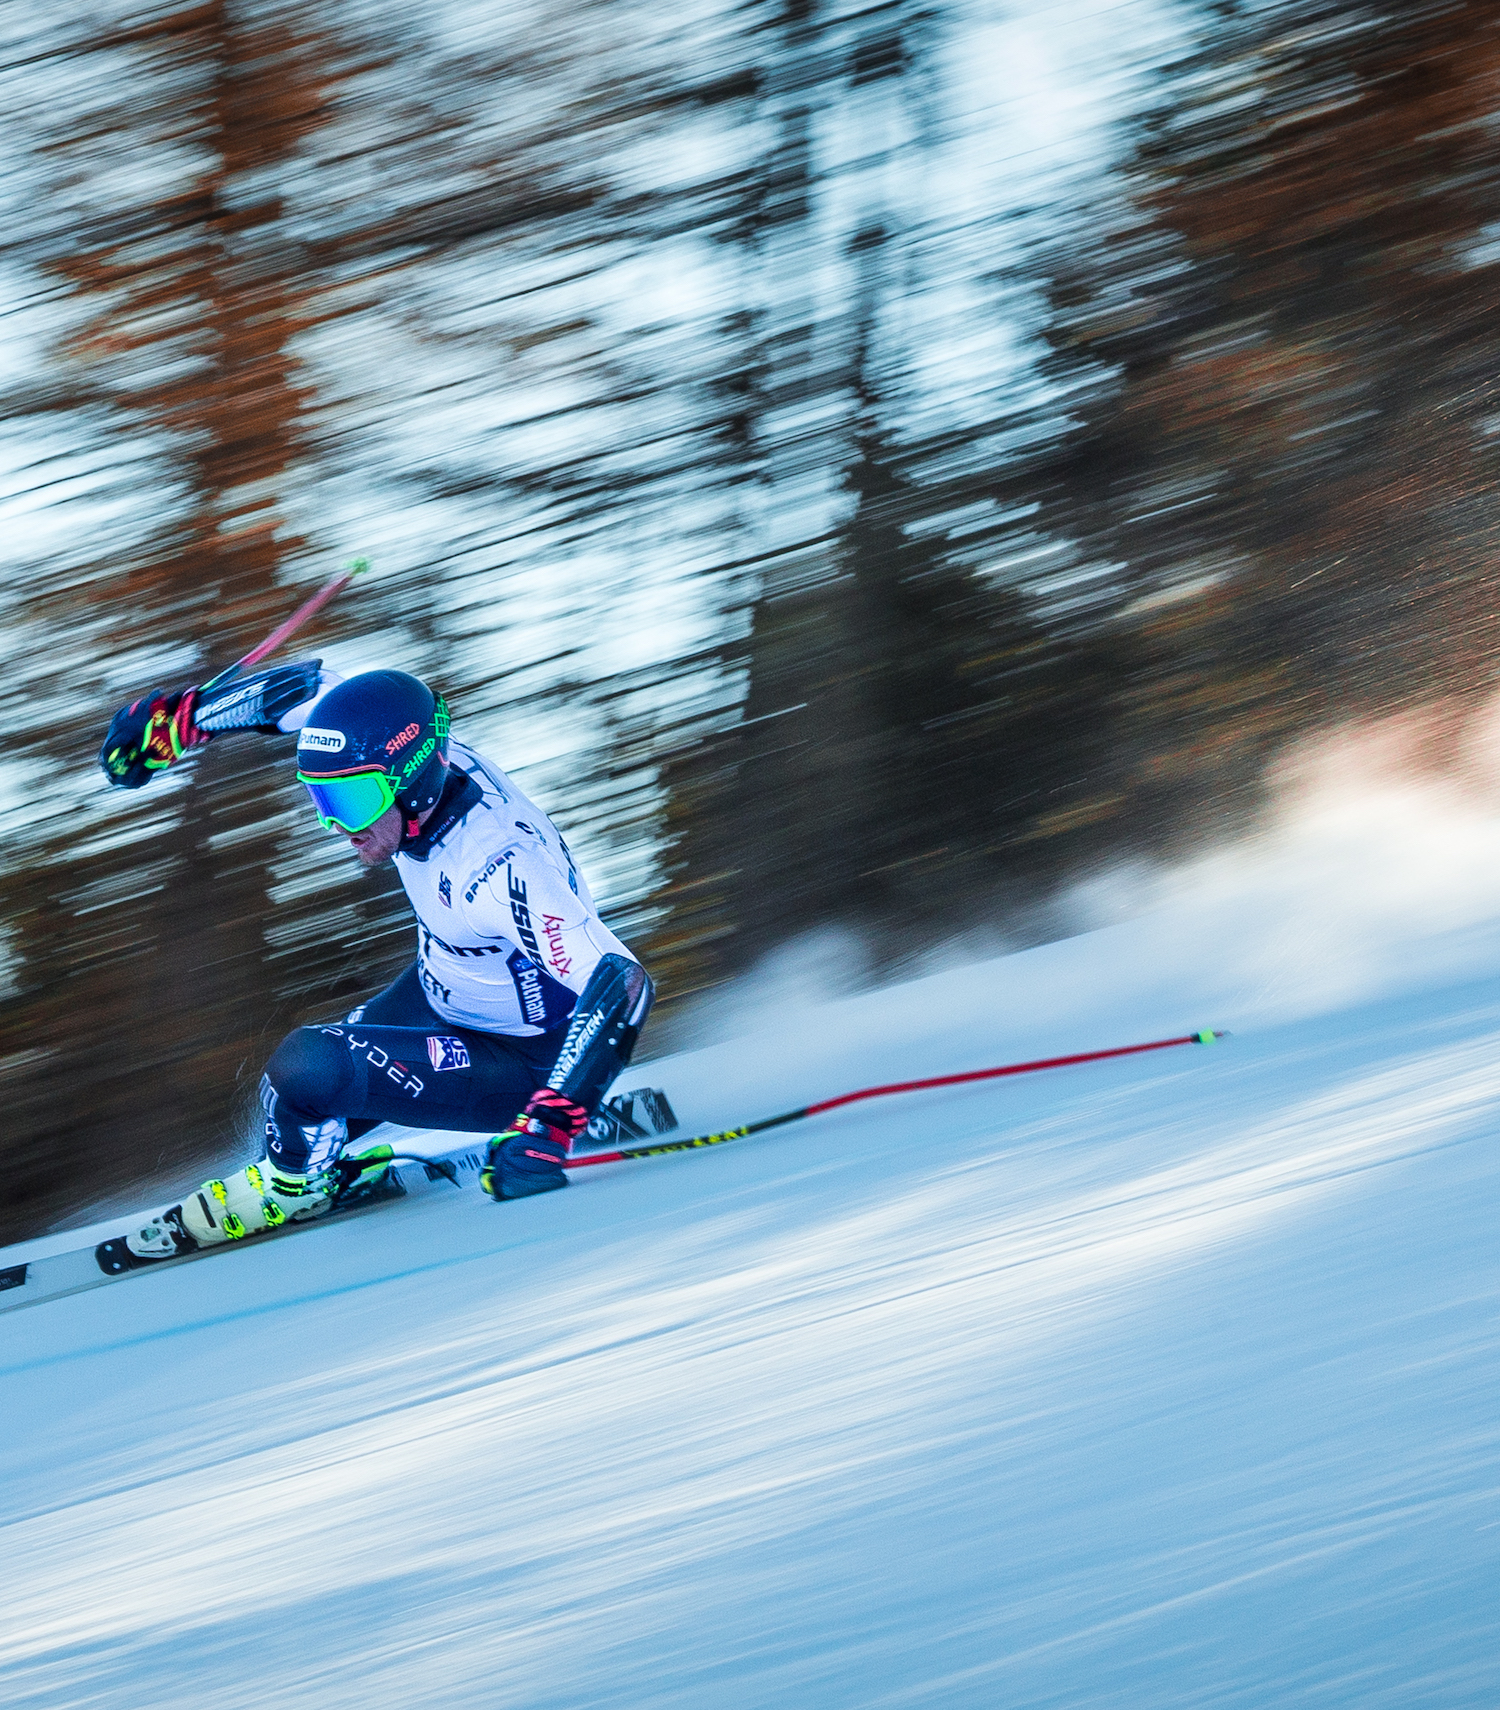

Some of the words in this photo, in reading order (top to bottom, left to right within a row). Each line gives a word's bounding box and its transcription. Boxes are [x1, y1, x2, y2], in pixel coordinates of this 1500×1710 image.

[385, 723, 420, 755] SHRED
[403, 738, 436, 778] SHRED
[465, 850, 516, 903] SPYDER
[507, 863, 550, 973] BOSE
[542, 914, 572, 977] xfinity
[517, 968, 547, 1022] Putnam
